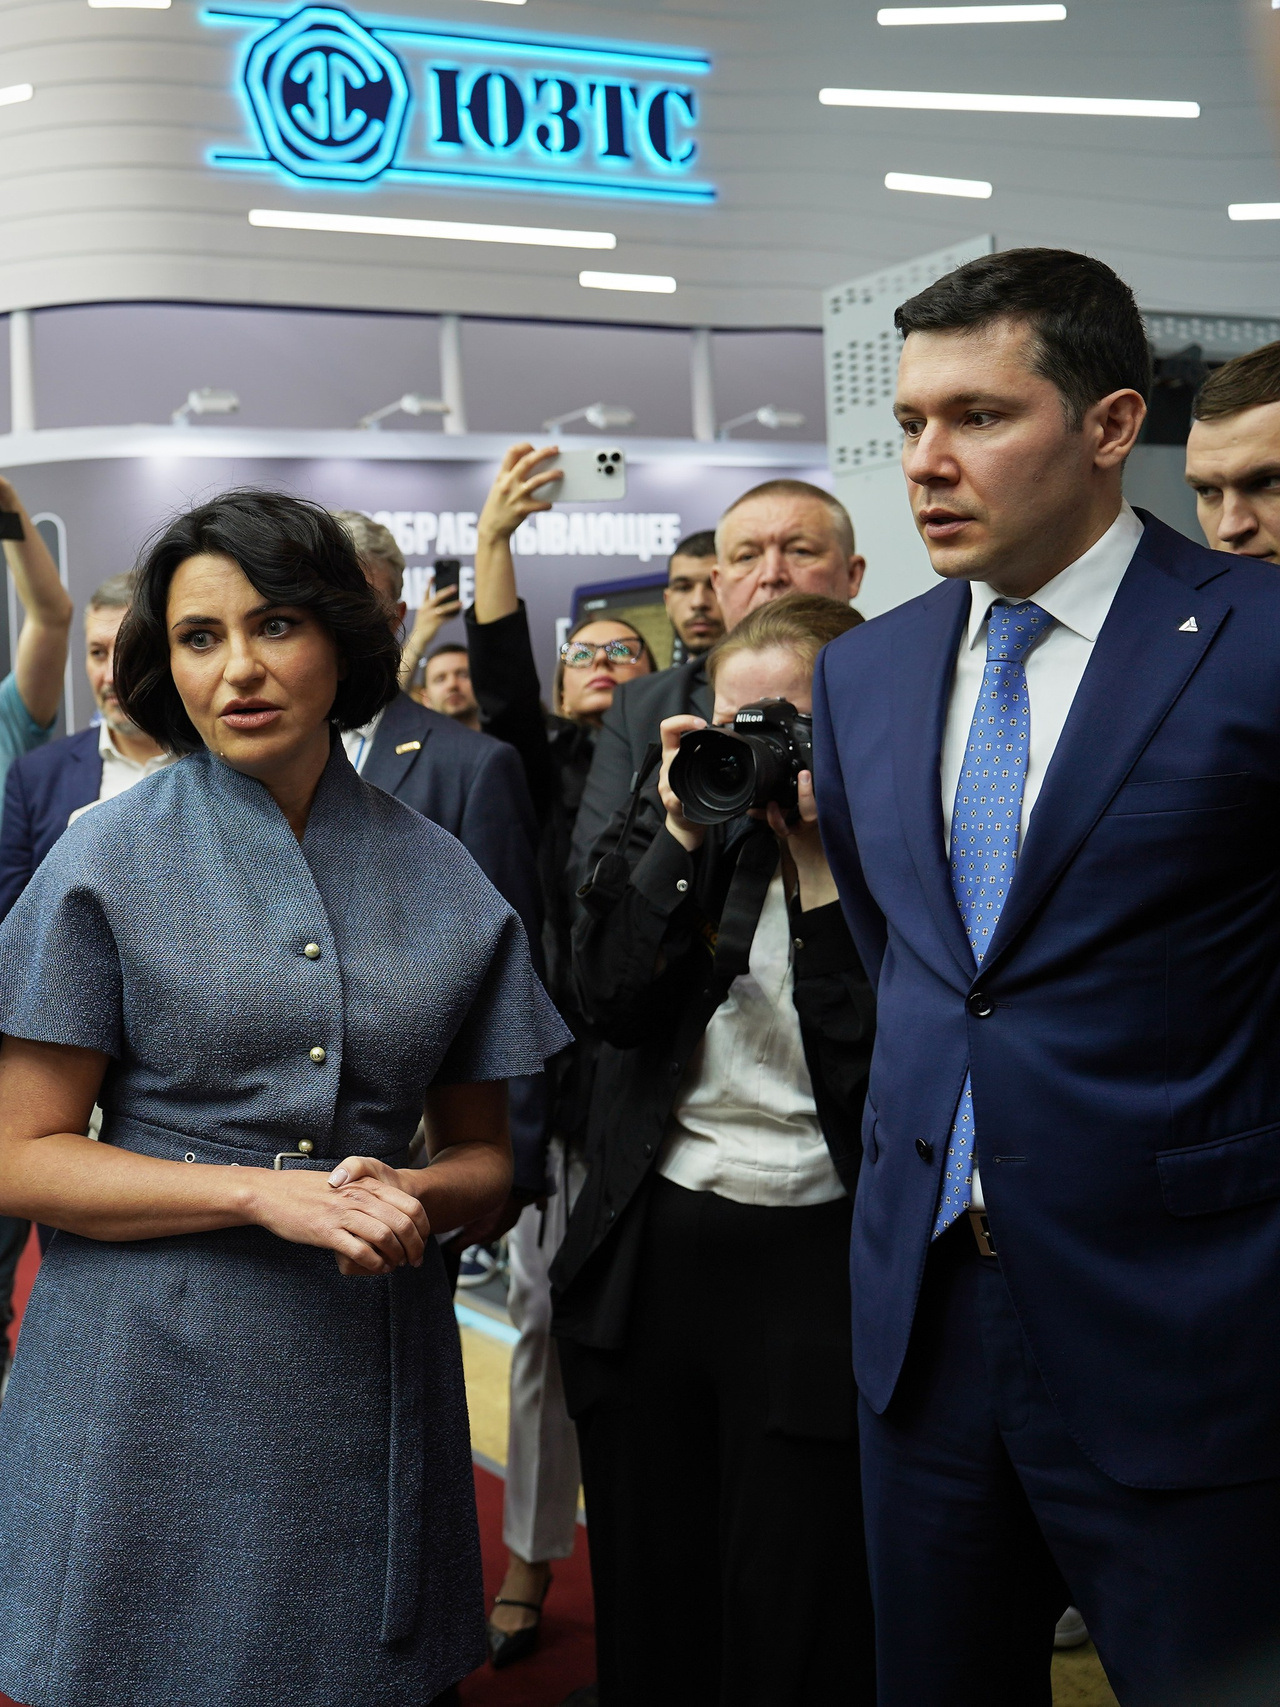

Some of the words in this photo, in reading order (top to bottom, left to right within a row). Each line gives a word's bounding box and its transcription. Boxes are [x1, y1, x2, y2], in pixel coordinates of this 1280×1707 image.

[431, 69, 696, 163] ЮЗТС
[360, 510, 681, 562] БРАБЫВАЮЩЕЕ
[735, 713, 763, 723] Nikon
